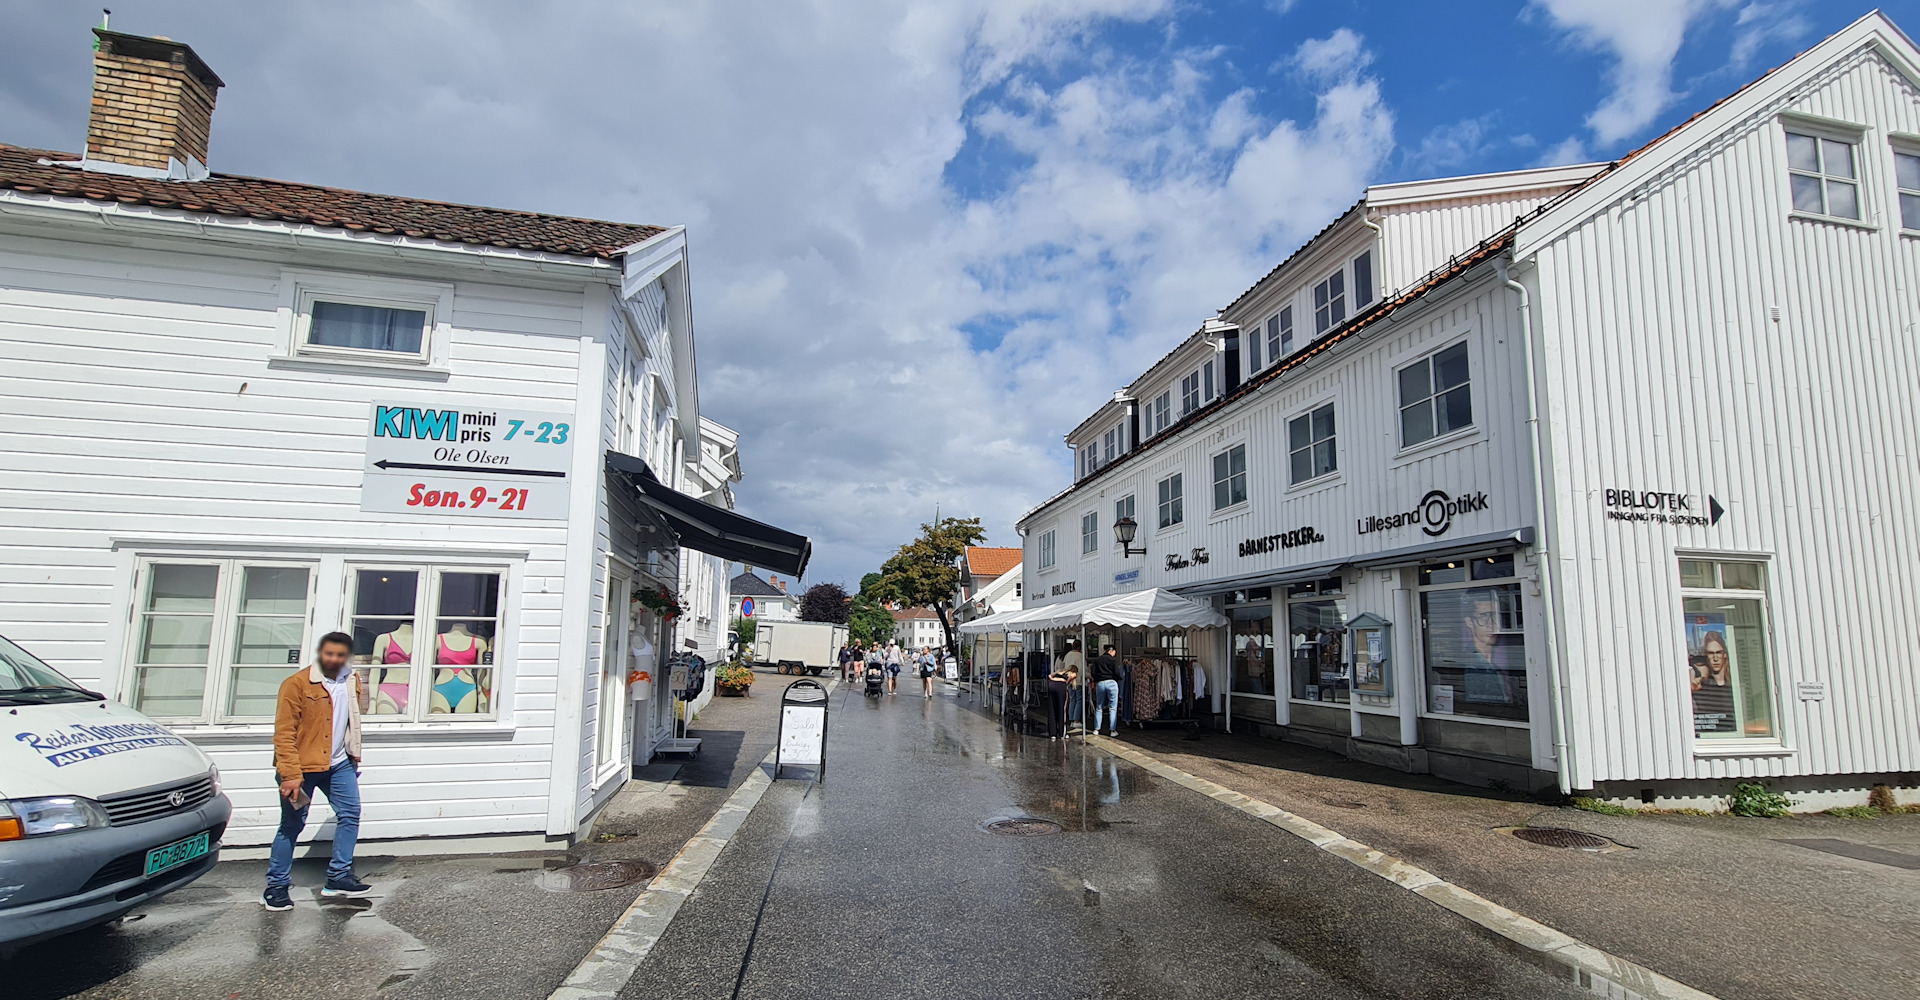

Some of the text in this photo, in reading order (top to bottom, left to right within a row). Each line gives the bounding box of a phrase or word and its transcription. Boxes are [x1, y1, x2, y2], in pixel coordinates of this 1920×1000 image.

[374, 405, 459, 442] KIWI
[462, 411, 497, 427] mini
[460, 428, 491, 443] pris
[503, 419, 570, 445] 7-23
[433, 447, 510, 465] Ole Olsen
[1605, 488, 1689, 511] BIBLIOTEK
[1357, 491, 1488, 535] Lillesand Optikk
[1607, 511, 1649, 522] INNGANG
[1651, 513, 1668, 523] FRA
[1052, 581, 1076, 596] BIBLIOTEK
[15, 729, 93, 754] Reidar
[57, 748, 100, 766] AUT.
